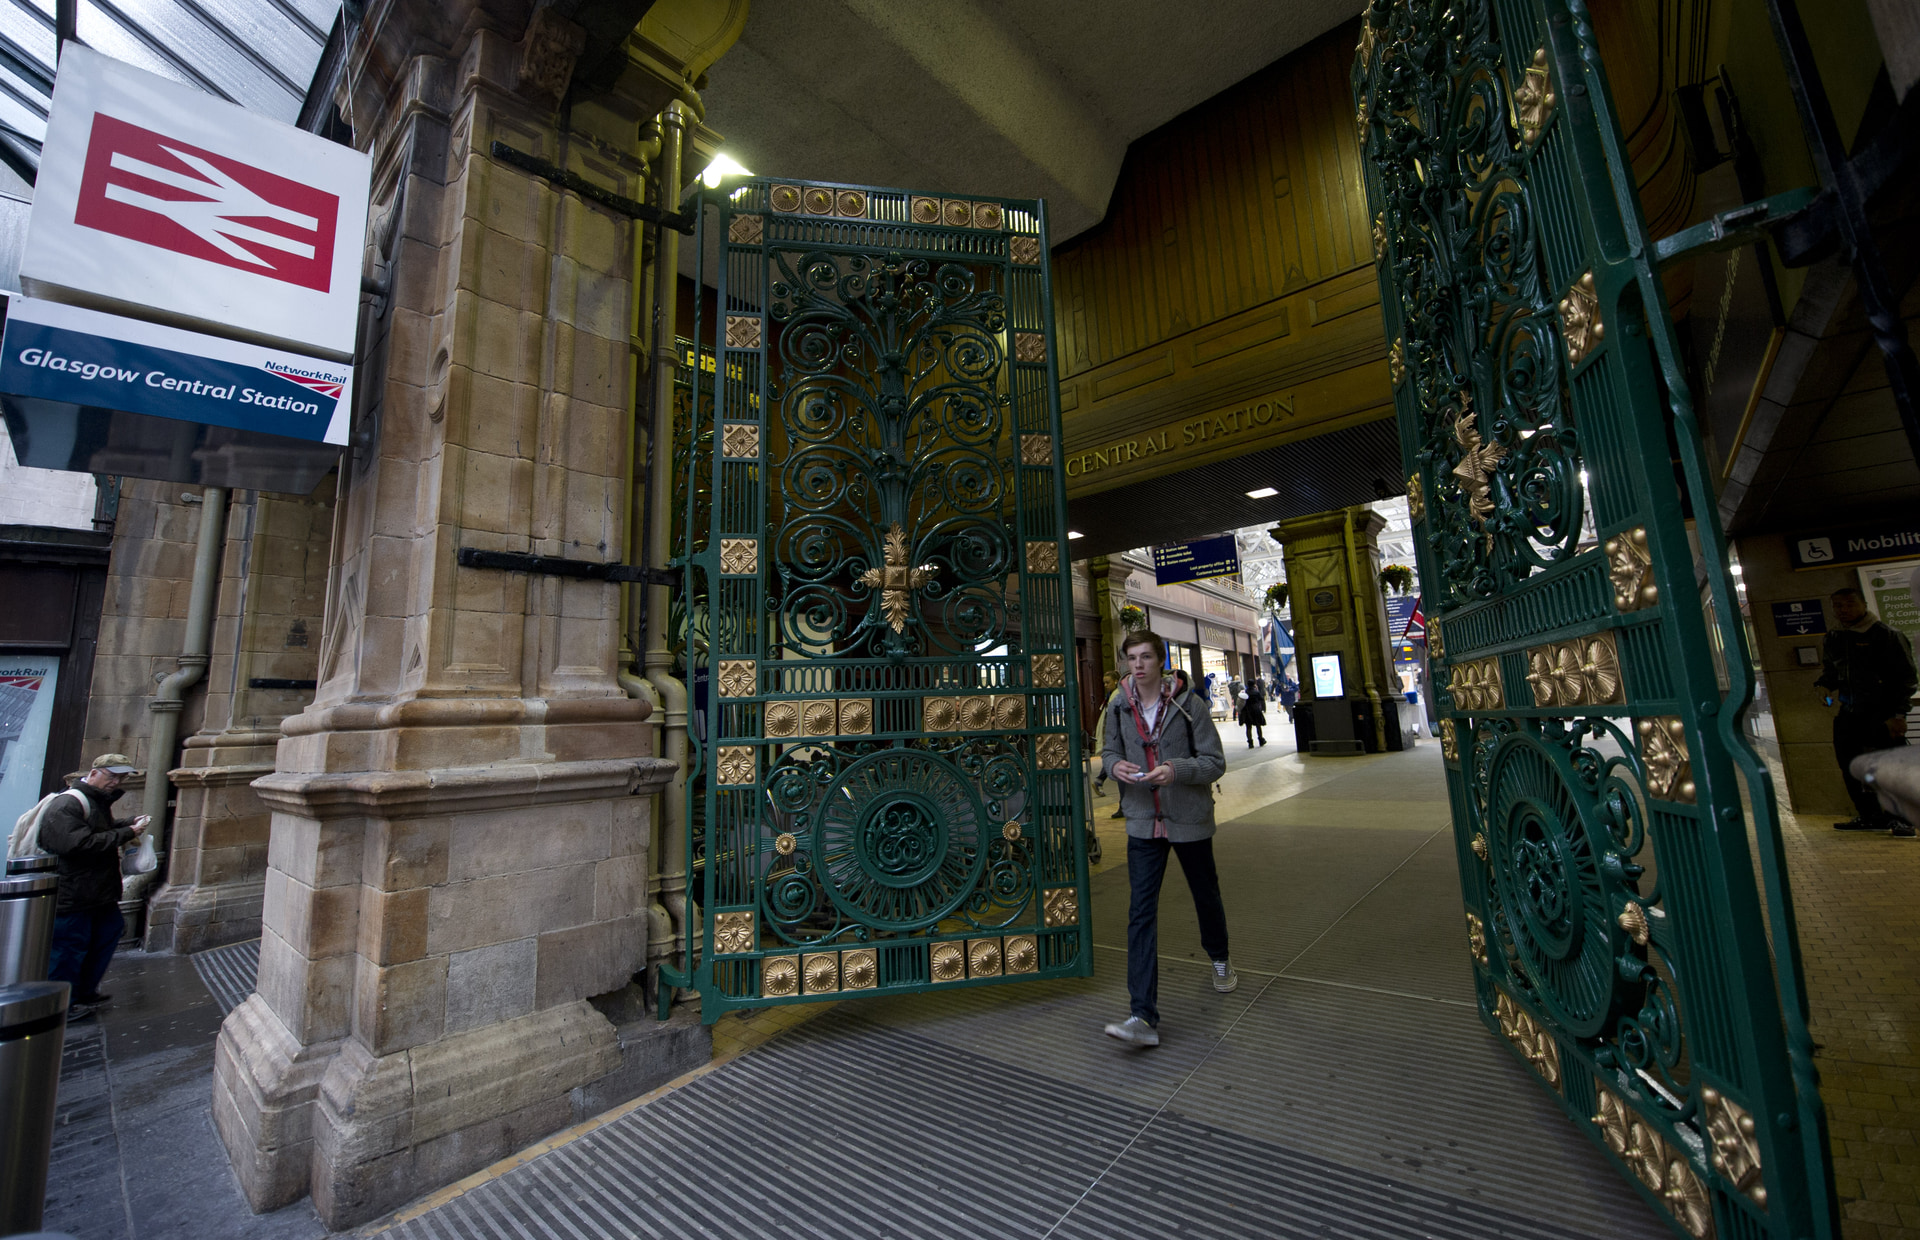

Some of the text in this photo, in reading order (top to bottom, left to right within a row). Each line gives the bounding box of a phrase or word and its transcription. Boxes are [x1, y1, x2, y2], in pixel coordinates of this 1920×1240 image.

[19, 348, 319, 415] Glasgow Central Station
[1065, 431, 1175, 477] CENTRAL
[1183, 395, 1295, 445] STATION
